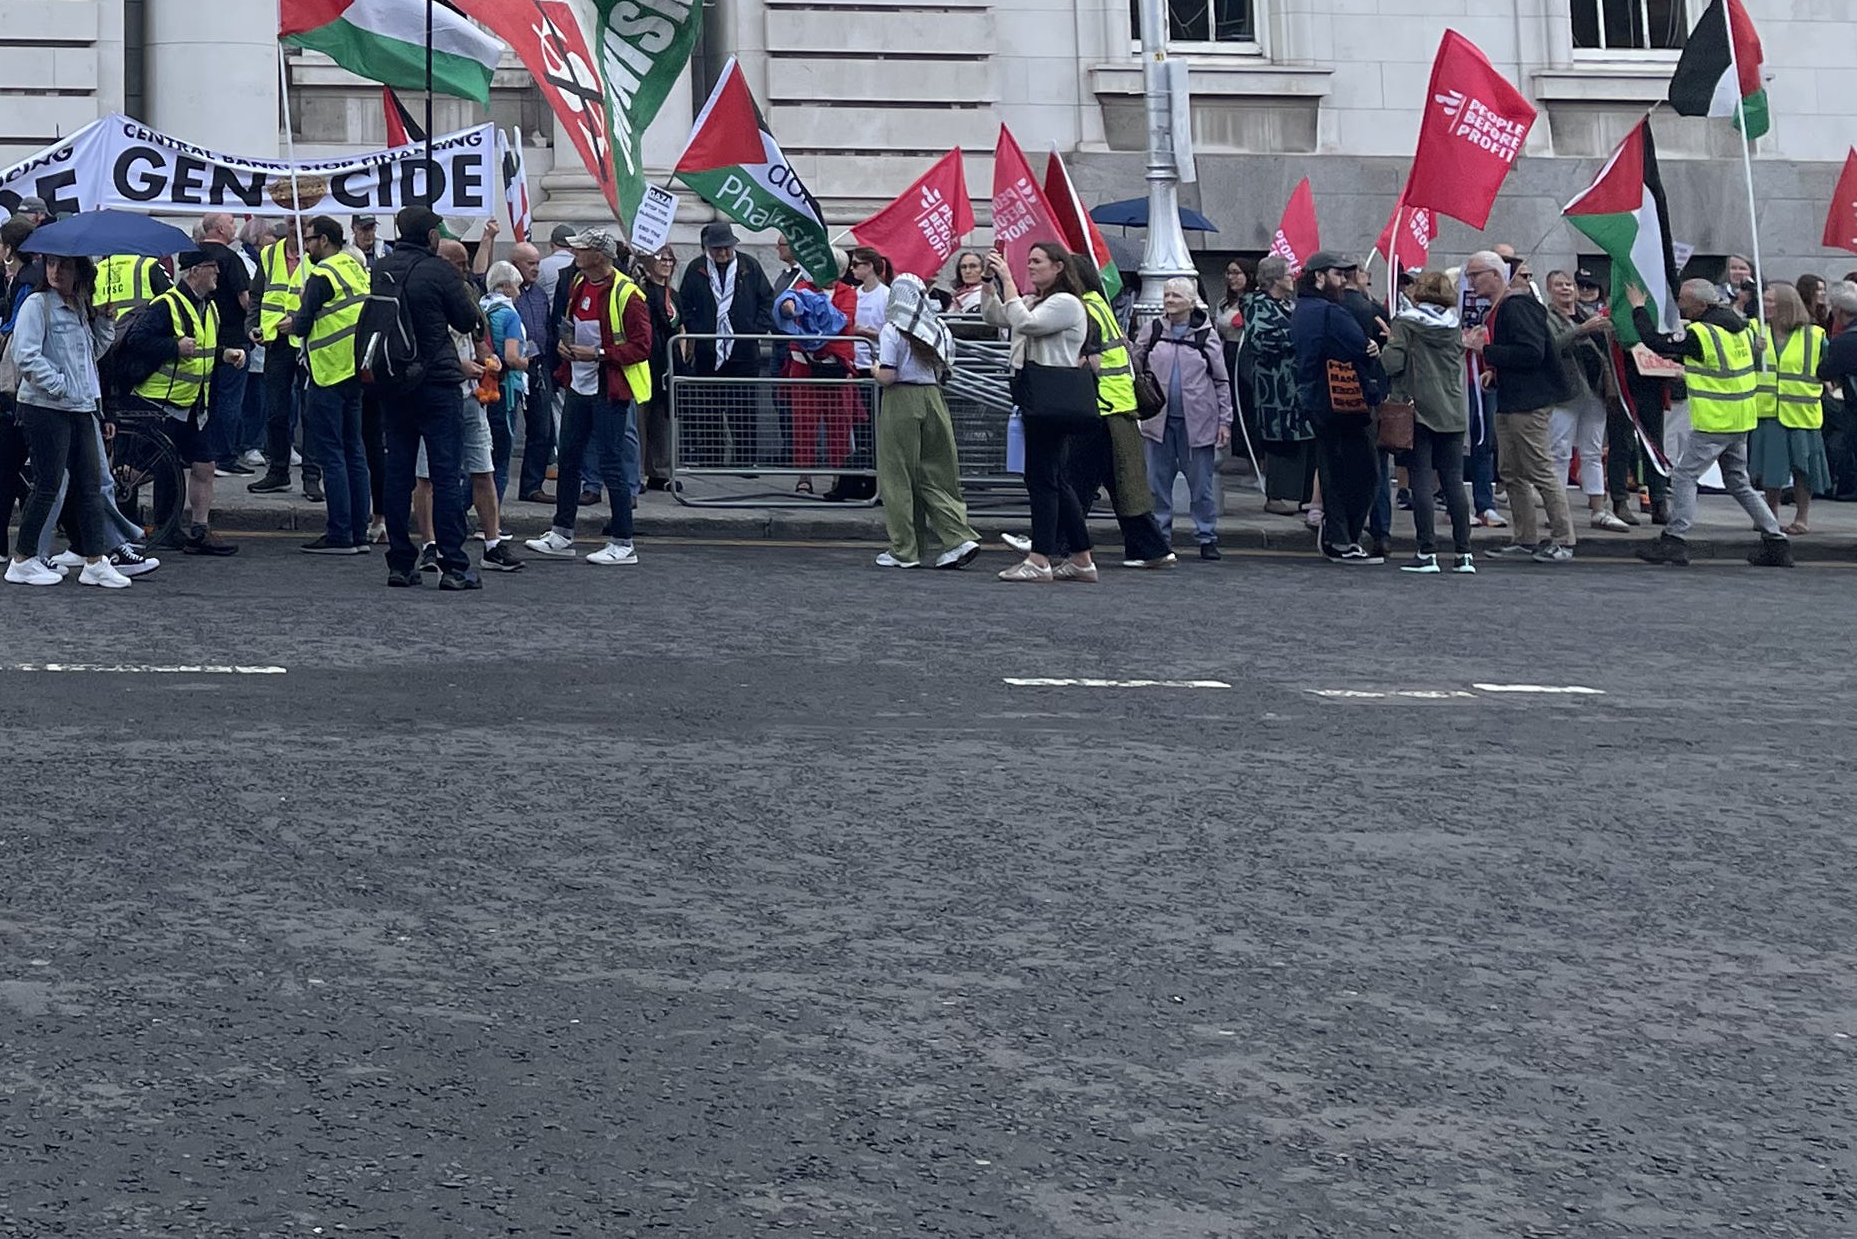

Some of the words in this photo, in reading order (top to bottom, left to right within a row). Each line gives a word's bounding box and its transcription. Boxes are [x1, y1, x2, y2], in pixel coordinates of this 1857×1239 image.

[1464, 110, 1521, 151] BEFORE
[1469, 99, 1525, 138] PEOPLE
[123, 123, 216, 160] CENTRAL
[1456, 124, 1515, 163] PROFIT
